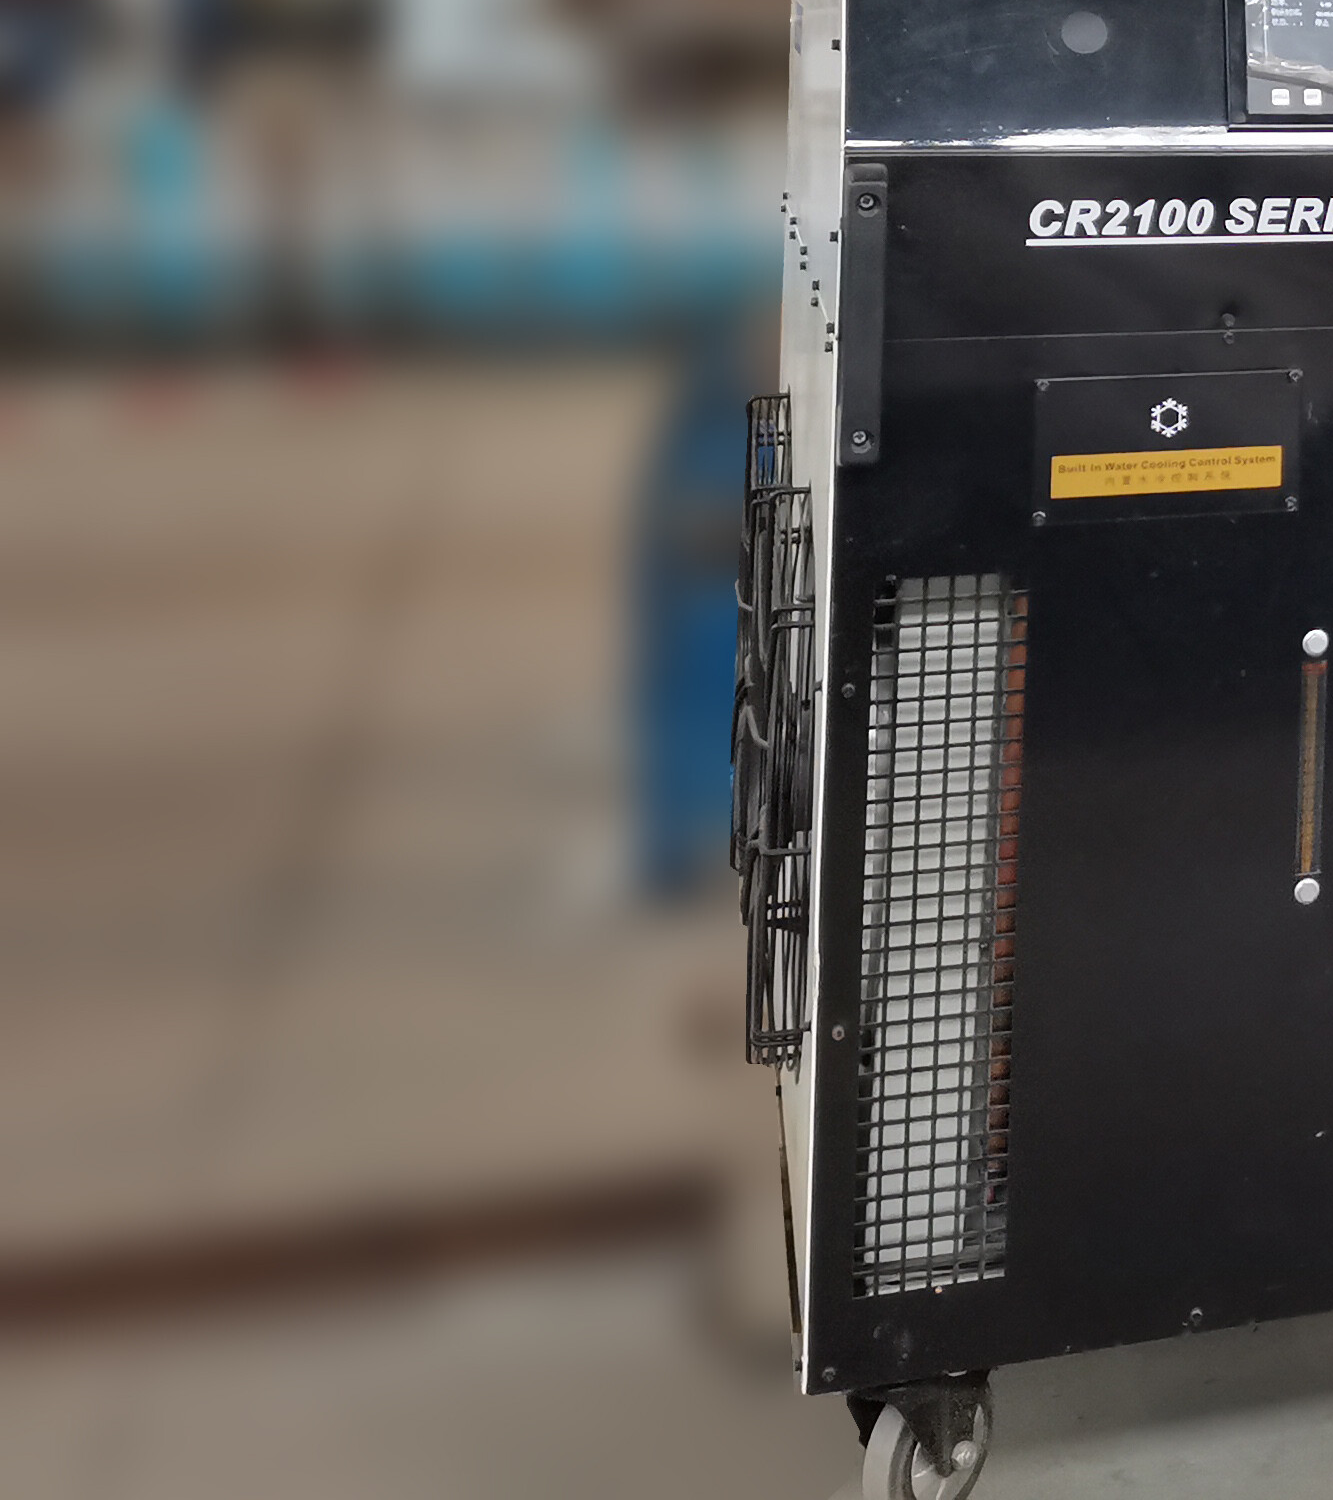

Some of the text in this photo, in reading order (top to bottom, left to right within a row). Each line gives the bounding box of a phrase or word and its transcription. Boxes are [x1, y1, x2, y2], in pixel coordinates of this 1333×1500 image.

[1028, 198, 1215, 237] CR2100
[1058, 455, 1276, 474] Built In Water Cooling Control System
